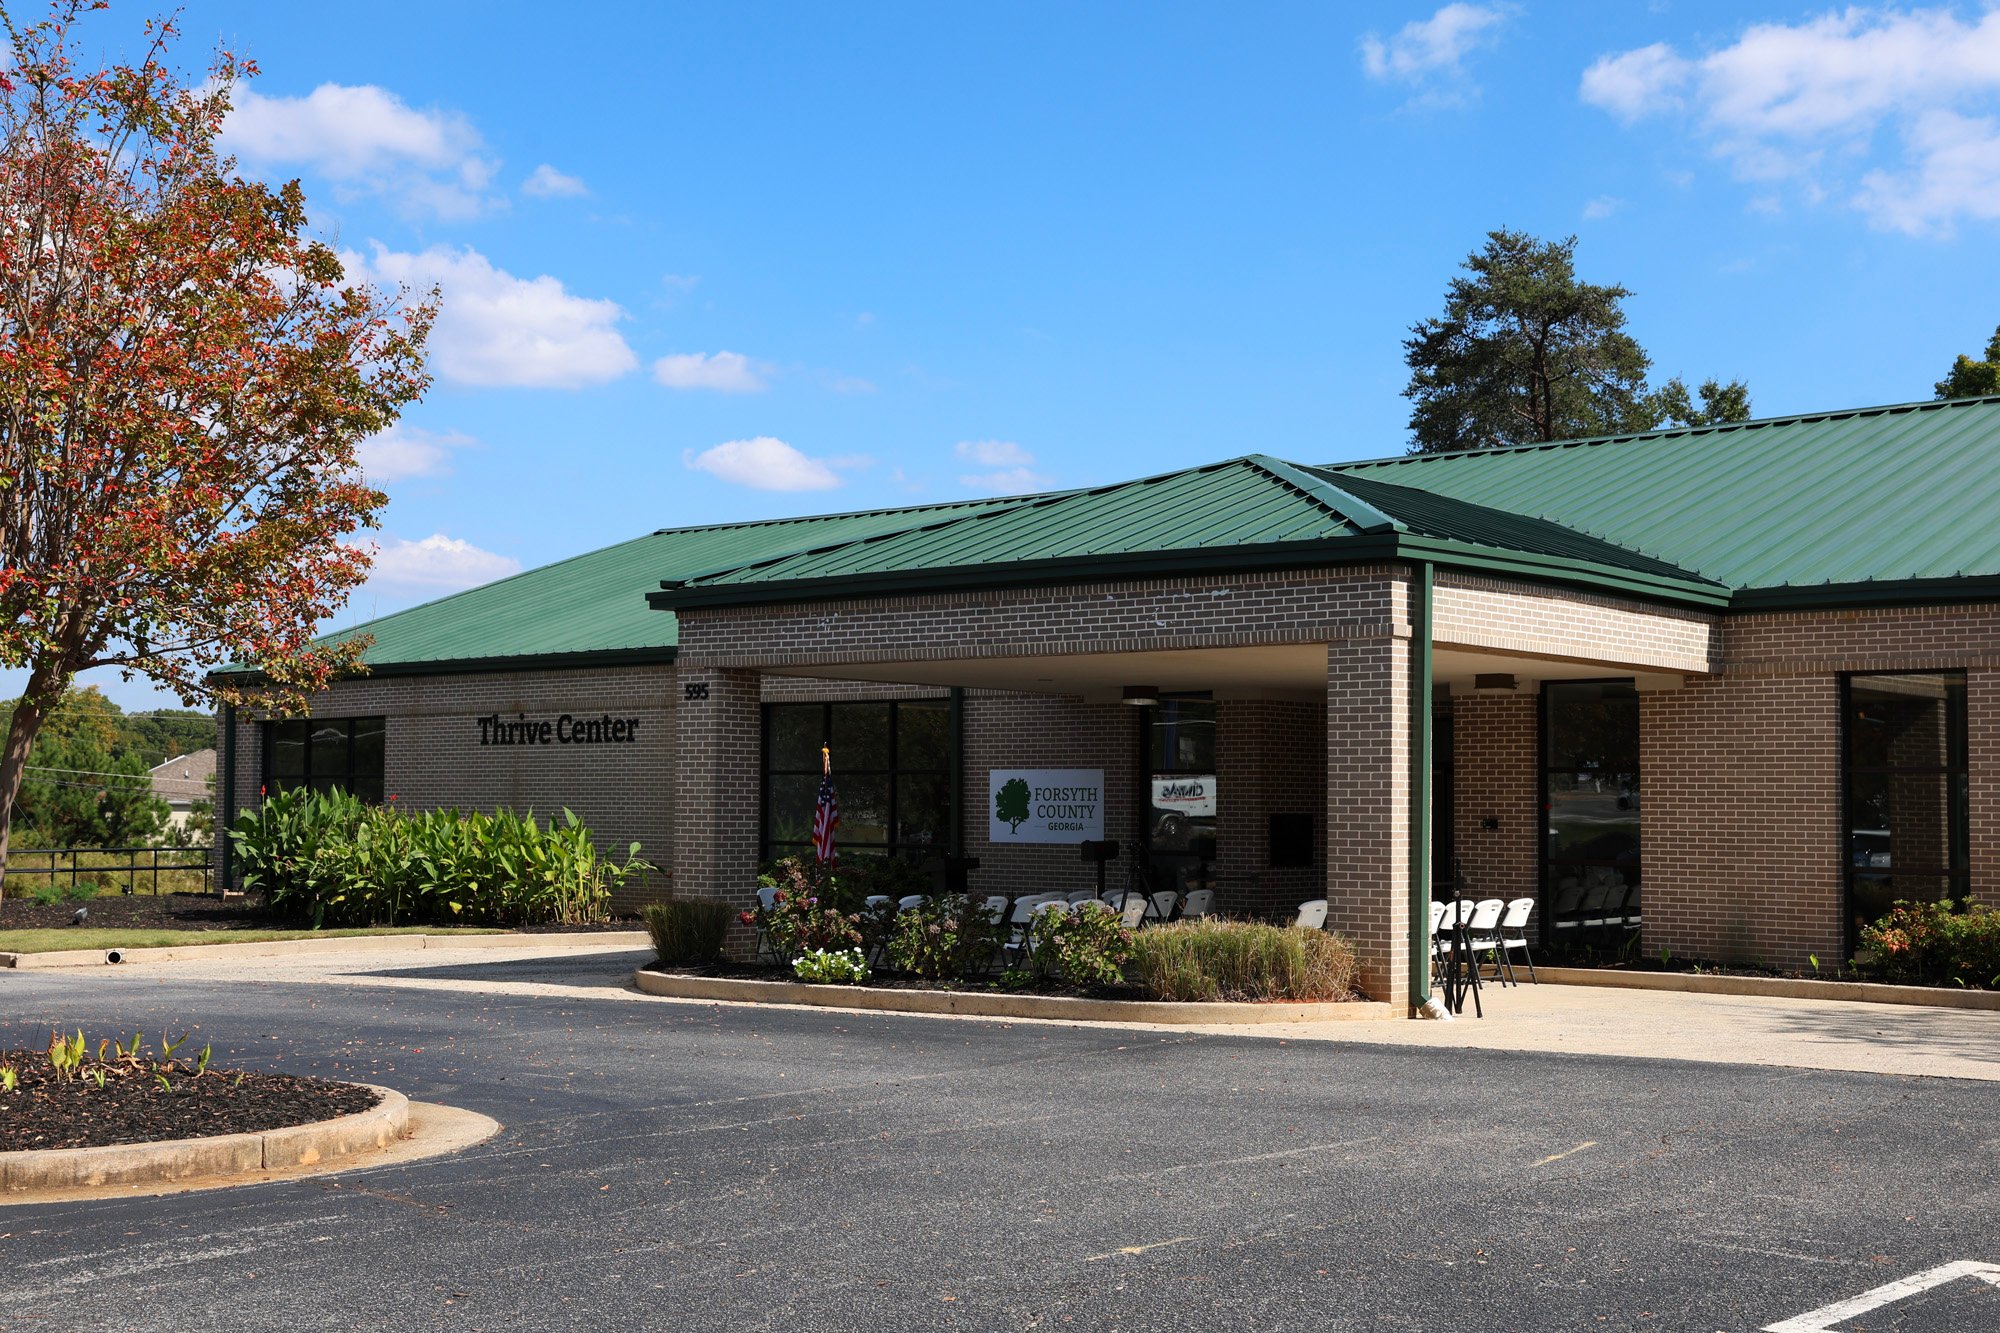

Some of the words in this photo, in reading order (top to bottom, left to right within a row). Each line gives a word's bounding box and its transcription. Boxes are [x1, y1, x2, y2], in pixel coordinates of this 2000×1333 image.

[685, 683, 709, 700] 595
[477, 713, 551, 745] Thrive
[556, 714, 639, 744] Center
[1034, 787, 1098, 802] FORSYTH
[1037, 804, 1096, 819] COUNTY
[1048, 822, 1084, 831] GEORGIA
